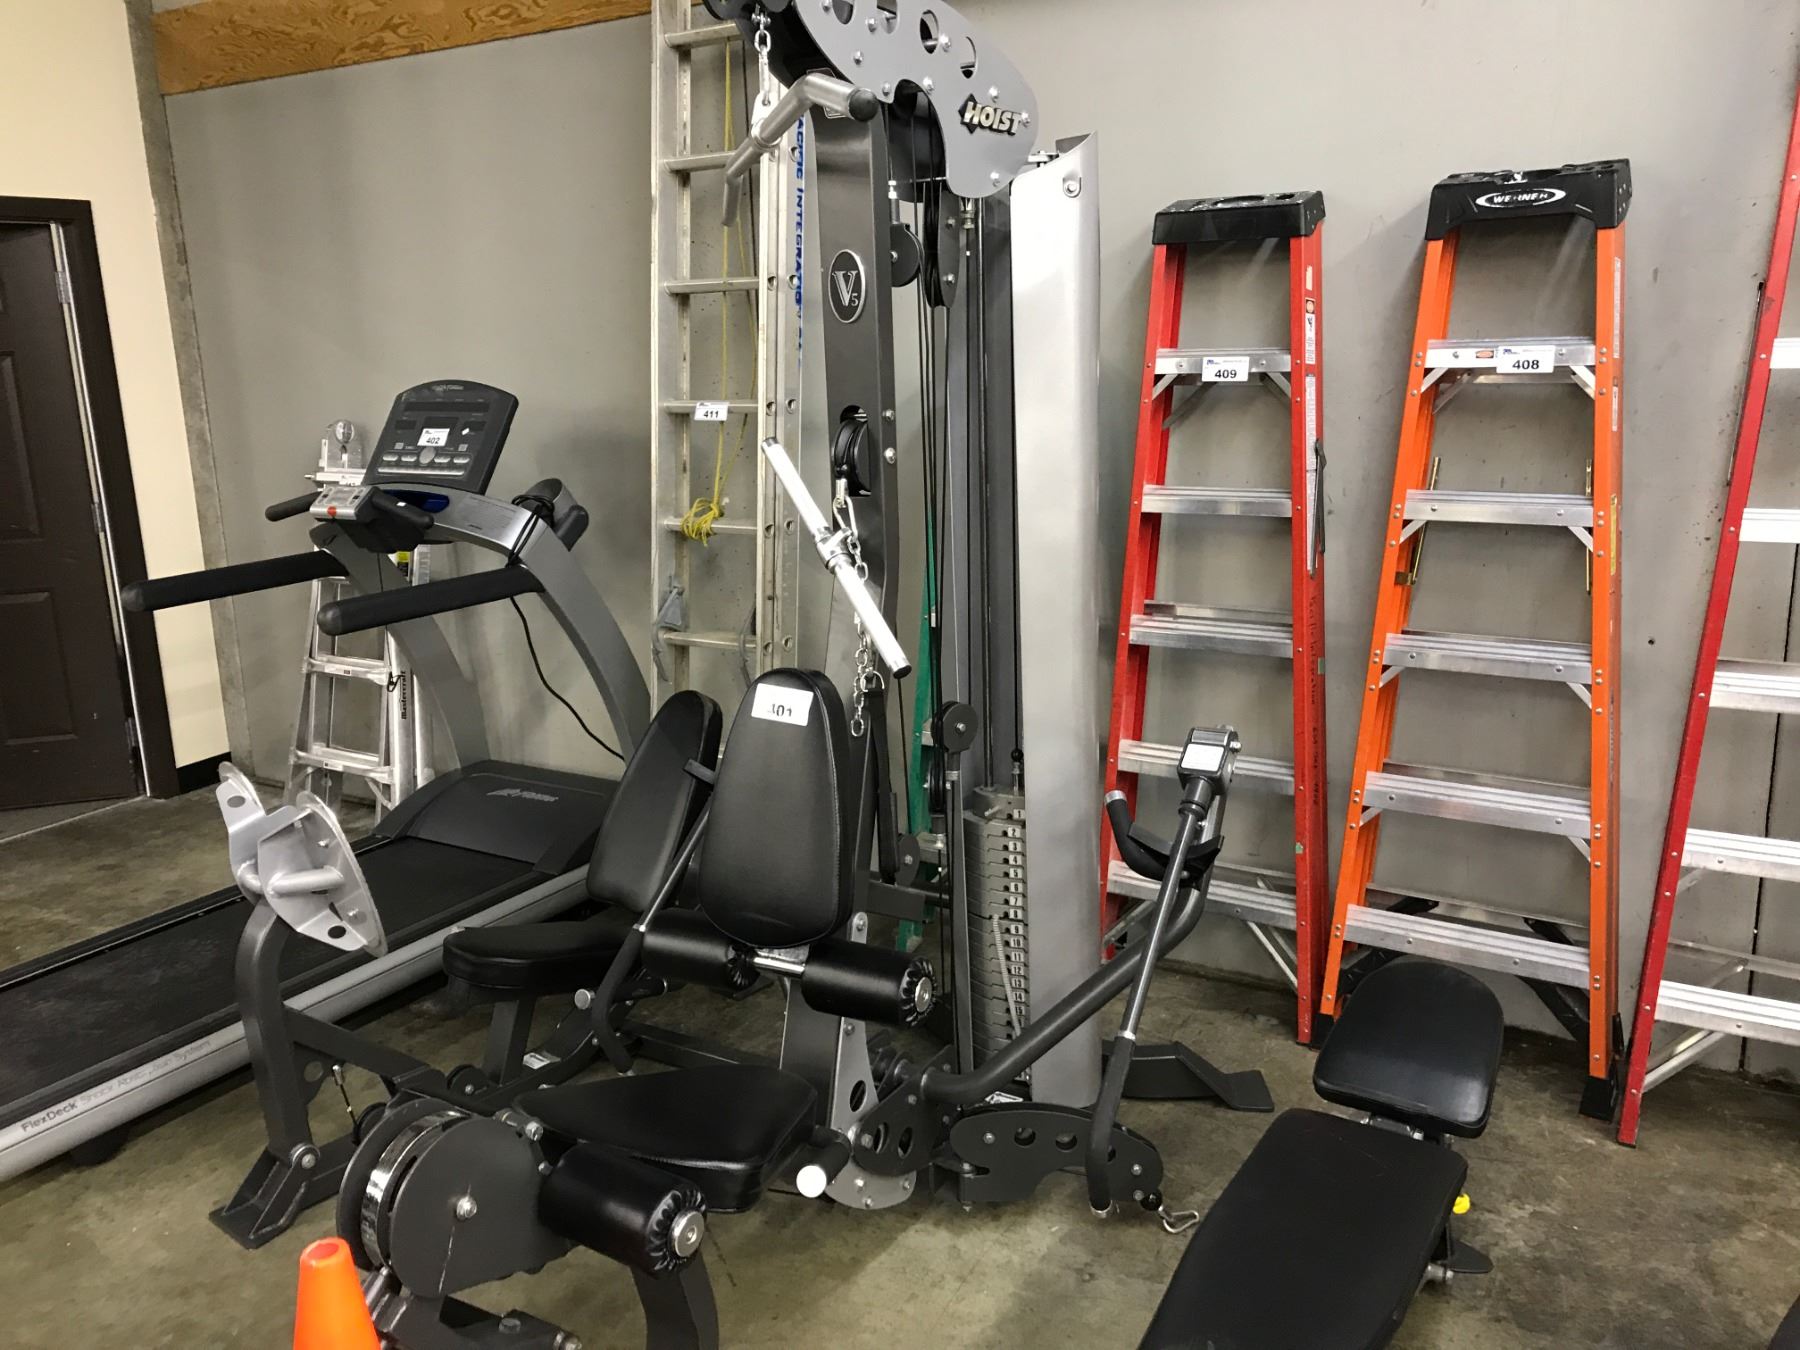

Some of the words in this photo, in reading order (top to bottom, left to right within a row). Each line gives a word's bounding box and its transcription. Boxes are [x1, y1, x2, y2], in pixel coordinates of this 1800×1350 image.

[963, 101, 1021, 133] HOIST
[1512, 359, 1540, 370] 408
[1214, 369, 1237, 379] 409
[703, 410, 719, 418] 411
[426, 436, 441, 445] 402
[1013, 966, 1022, 974] 12
[20, 1099, 79, 1133] FlexDeck
